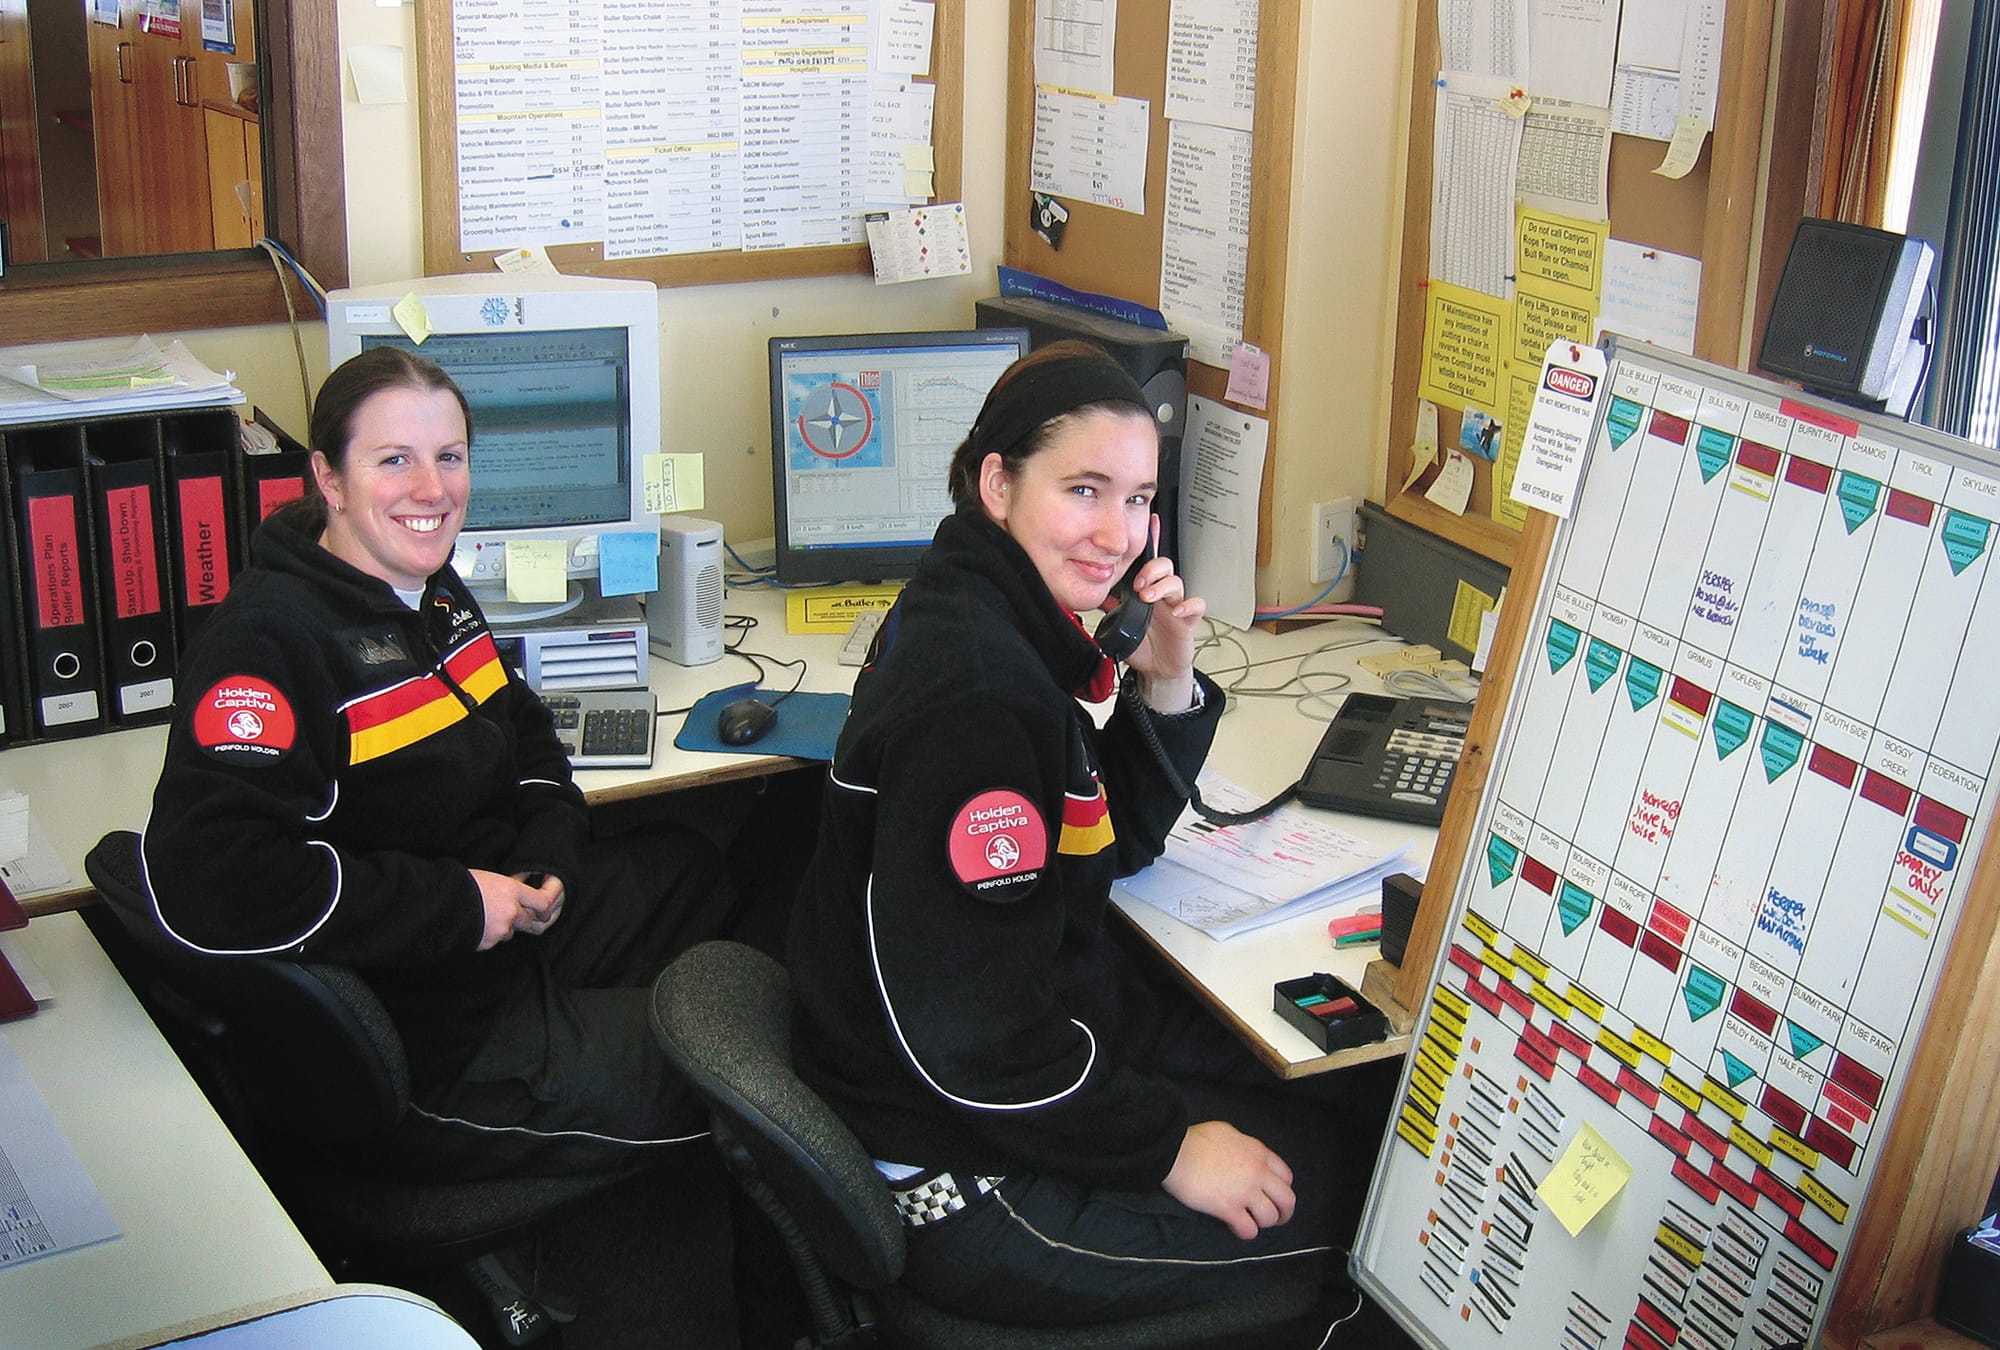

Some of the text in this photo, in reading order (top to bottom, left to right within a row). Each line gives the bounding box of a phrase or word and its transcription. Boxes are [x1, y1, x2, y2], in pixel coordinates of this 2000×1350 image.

[1523, 234, 1540, 248] Rope
[1541, 238, 1558, 251] Tows
[1564, 230, 1588, 245] Canyon
[1538, 251, 1552, 262] Run
[1560, 256, 1589, 272] Chamois
[1550, 371, 1590, 395] DANGER
[1618, 366, 1658, 386] BLUE BULLET
[1626, 385, 1640, 397] ONE
[1662, 381, 1698, 400] HORSE HILL
[1708, 395, 1740, 413] BULL RUN
[1752, 409, 1788, 429] EMIRATES
[1798, 423, 1840, 445] BURNT HUT
[1851, 441, 1888, 461] CHAMOIS
[1911, 460, 1934, 478] TIROL
[1521, 482, 1564, 504] SEE OTHER SIDE
[1961, 476, 1999, 498] SKYLINE
[119, 502, 130, 535] Down
[122, 538, 132, 564] Shut
[198, 520, 216, 604] Weather
[44, 534, 60, 625] Operations Plan
[59, 543, 74, 624] Buller Reports
[127, 588, 137, 616] Start
[1555, 590, 1594, 613] BLUE BULLET
[1564, 610, 1578, 623] TWO
[1601, 610, 1629, 628] WOMBAT
[1686, 650, 1714, 670] GRIMUS
[1730, 670, 1764, 692] KOFLERS
[138, 689, 155, 698] 2007
[218, 687, 272, 702] Holden
[1780, 692, 1810, 713] SUMMIT
[57, 701, 75, 712] 2007
[214, 698, 276, 712] Captiva
[1823, 712, 1870, 741] SOUTH SIDE
[214, 744, 280, 756] PENFOLD HOLDEN
[1883, 740, 1915, 761] BOGGY
[1880, 757, 1910, 778] CREEK
[1927, 762, 1980, 795] FEDERATION
[969, 804, 1022, 822] Holden
[1500, 808, 1526, 828] CANYON
[967, 816, 1029, 836] Captiva
[1493, 820, 1526, 846] ROPE TOWS
[1540, 832, 1560, 850] SPURS
[1572, 852, 1606, 878] BOURKE ST
[1896, 851, 1943, 884] SPARKY
[976, 872, 1038, 891] PENFOLD HOLDEN
[1570, 868, 1596, 889] CARPET
[1614, 878, 1648, 904] DAM ROPE
[1908, 874, 1945, 906] ONLY
[1618, 896, 1634, 913] TOW
[1698, 930, 1741, 962] BLUFF VIEW
[1749, 960, 1787, 990] BEGINNER
[1751, 980, 1774, 1000] PARK
[1792, 984, 1844, 1026] SUMMIT PARK
[1726, 1020, 1770, 1054] BALDY PARK
[1848, 1022, 1894, 1056] TUBE PARK
[1776, 1054, 1816, 1086] HALF PIPE
[1827, 1086, 1870, 1120] RECOVERY
